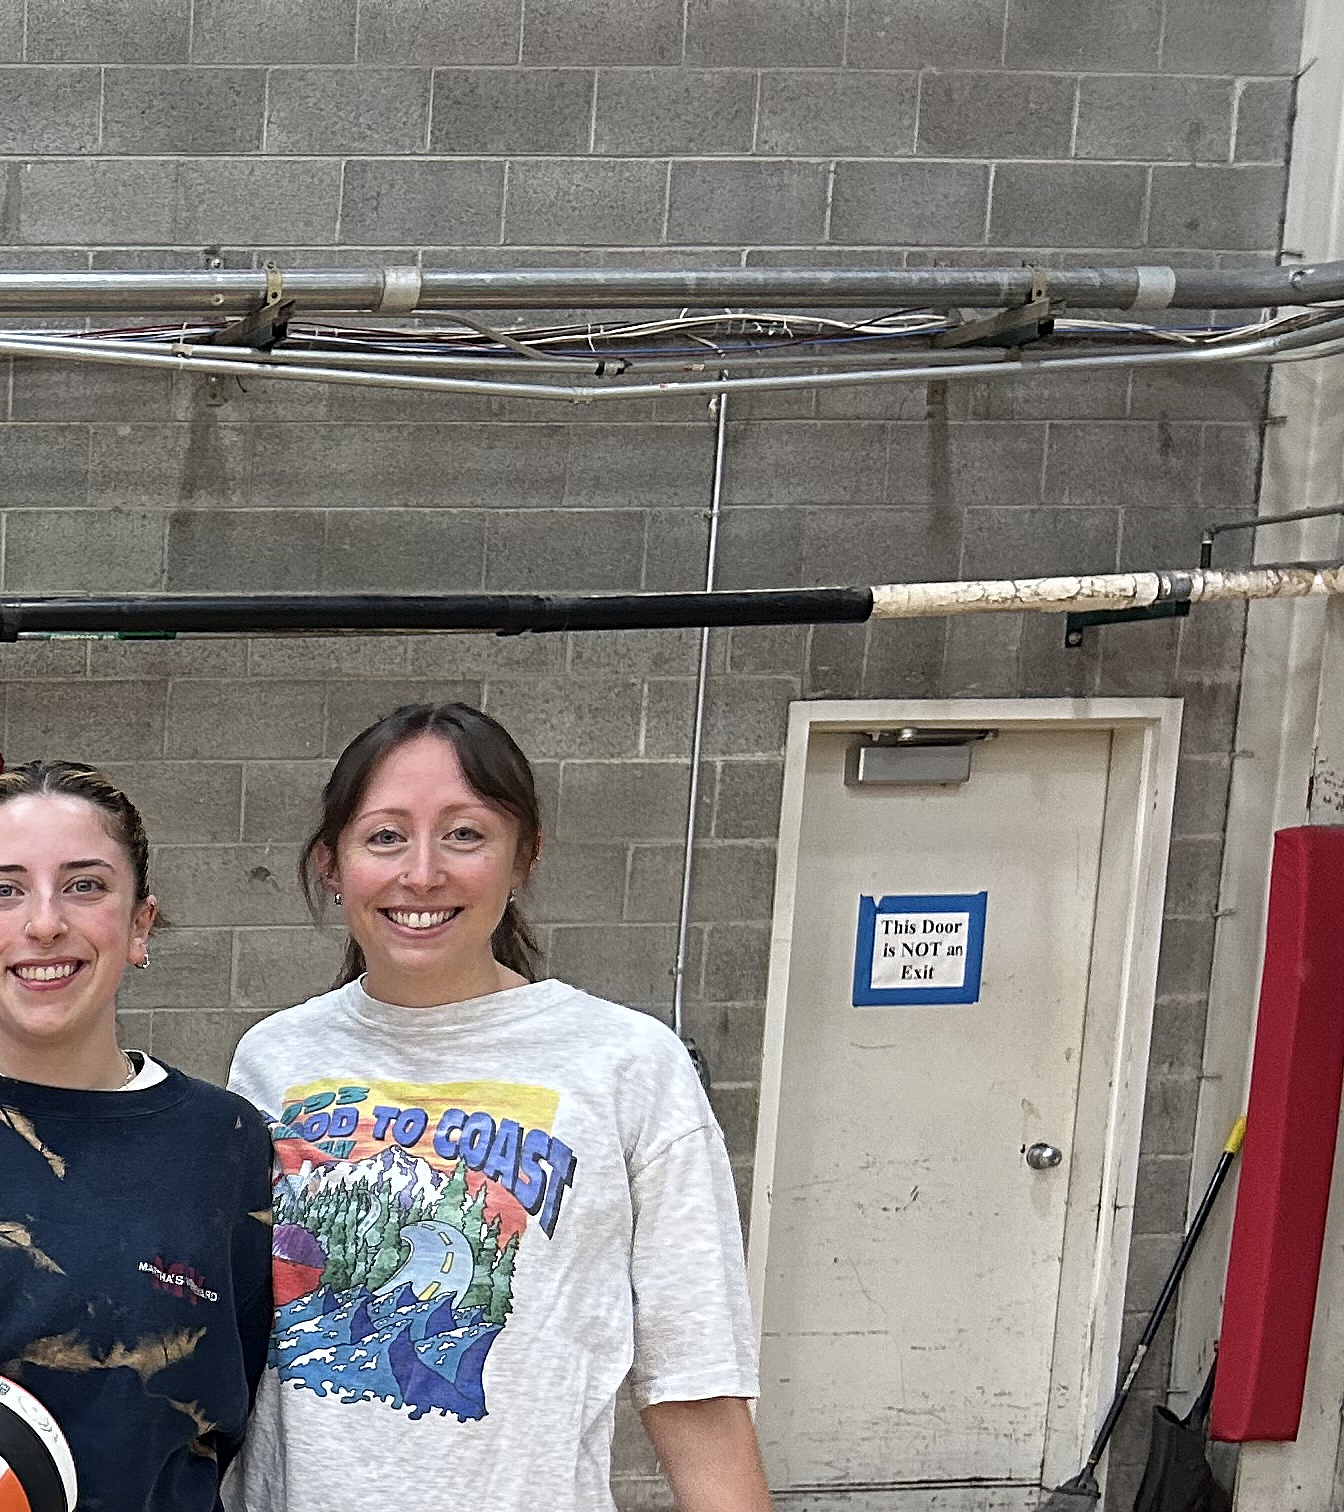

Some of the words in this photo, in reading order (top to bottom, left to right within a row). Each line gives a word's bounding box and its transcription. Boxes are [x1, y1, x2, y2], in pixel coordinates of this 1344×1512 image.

[881, 919, 916, 935] This
[922, 919, 963, 934] Door
[883, 943, 896, 958] is
[901, 941, 942, 958] NOT
[946, 945, 963, 957] an
[901, 964, 935, 980] Exit
[372, 1105, 429, 1148] TO
[432, 1107, 578, 1241] COAST
